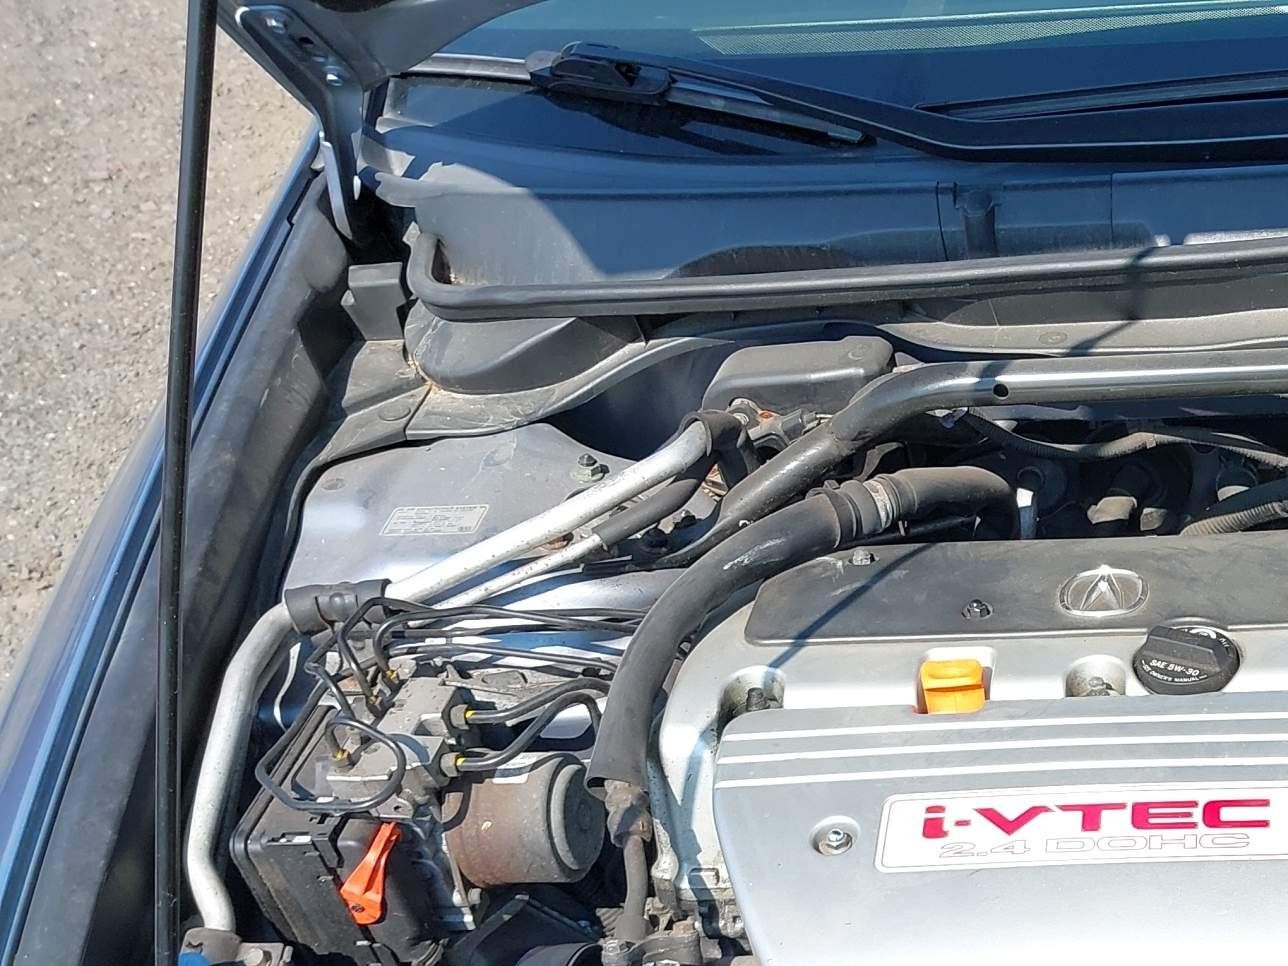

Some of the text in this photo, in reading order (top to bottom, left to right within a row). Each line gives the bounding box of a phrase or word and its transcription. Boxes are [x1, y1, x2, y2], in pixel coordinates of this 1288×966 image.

[1149, 660, 1199, 676] SAE 5W-30
[922, 799, 1270, 838] i-VTEC
[938, 833, 1250, 858] 2.4 DOHC
